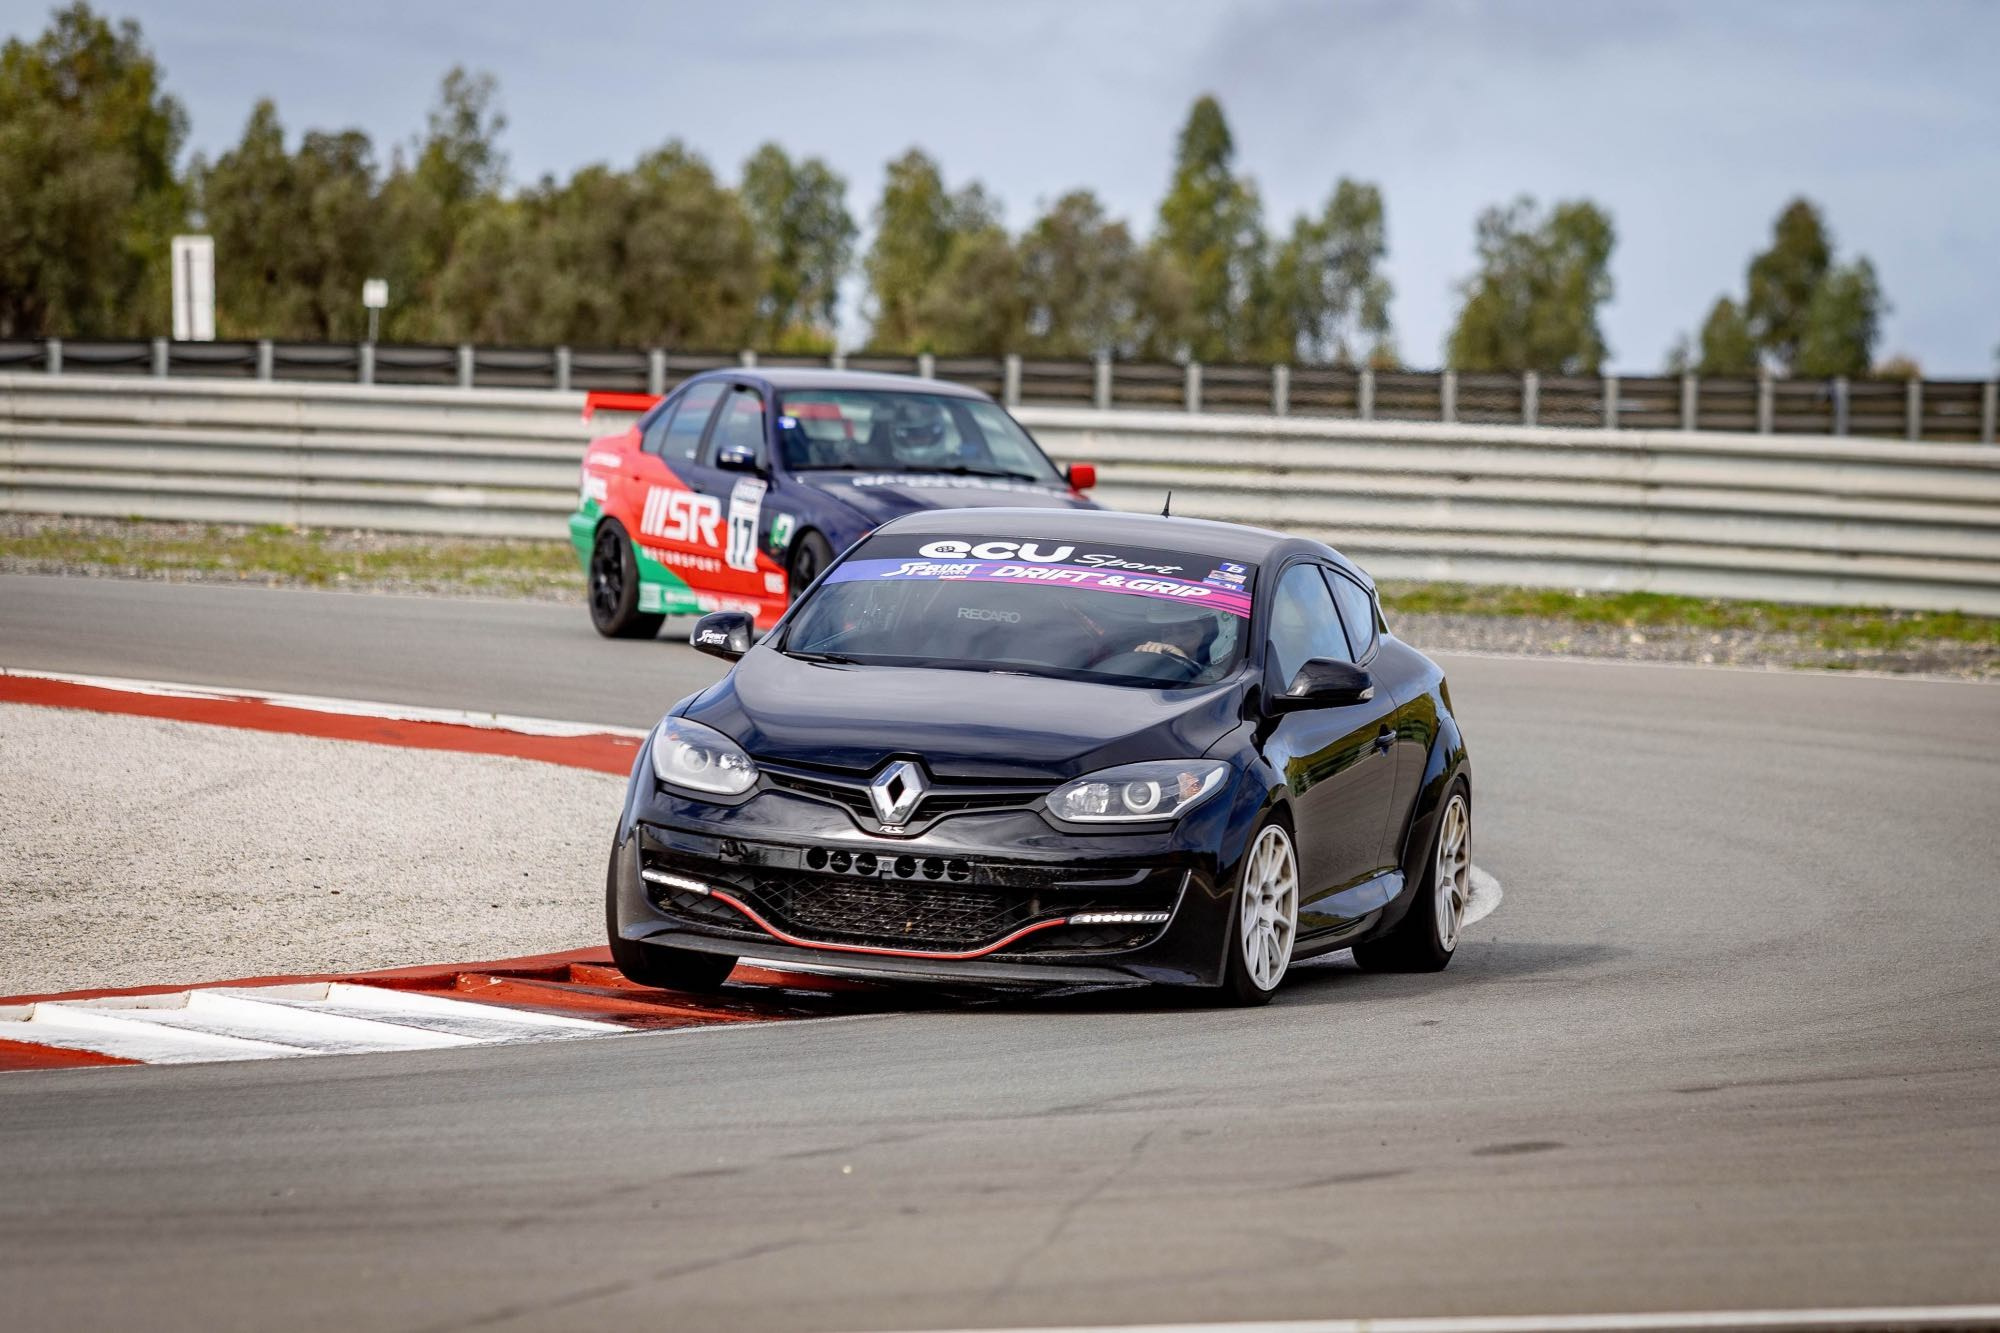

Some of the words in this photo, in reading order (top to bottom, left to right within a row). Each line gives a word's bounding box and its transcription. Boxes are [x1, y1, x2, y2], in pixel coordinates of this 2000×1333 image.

[732, 516, 754, 566] 17
[641, 545, 721, 573] MOTORSPORT
[1074, 554, 1183, 575] Sport
[989, 565, 1107, 583] DRIFT
[1097, 575, 1126, 588] &
[1125, 579, 1212, 597] GRIP
[957, 607, 1021, 624] RECARO
[879, 825, 905, 834] RS
